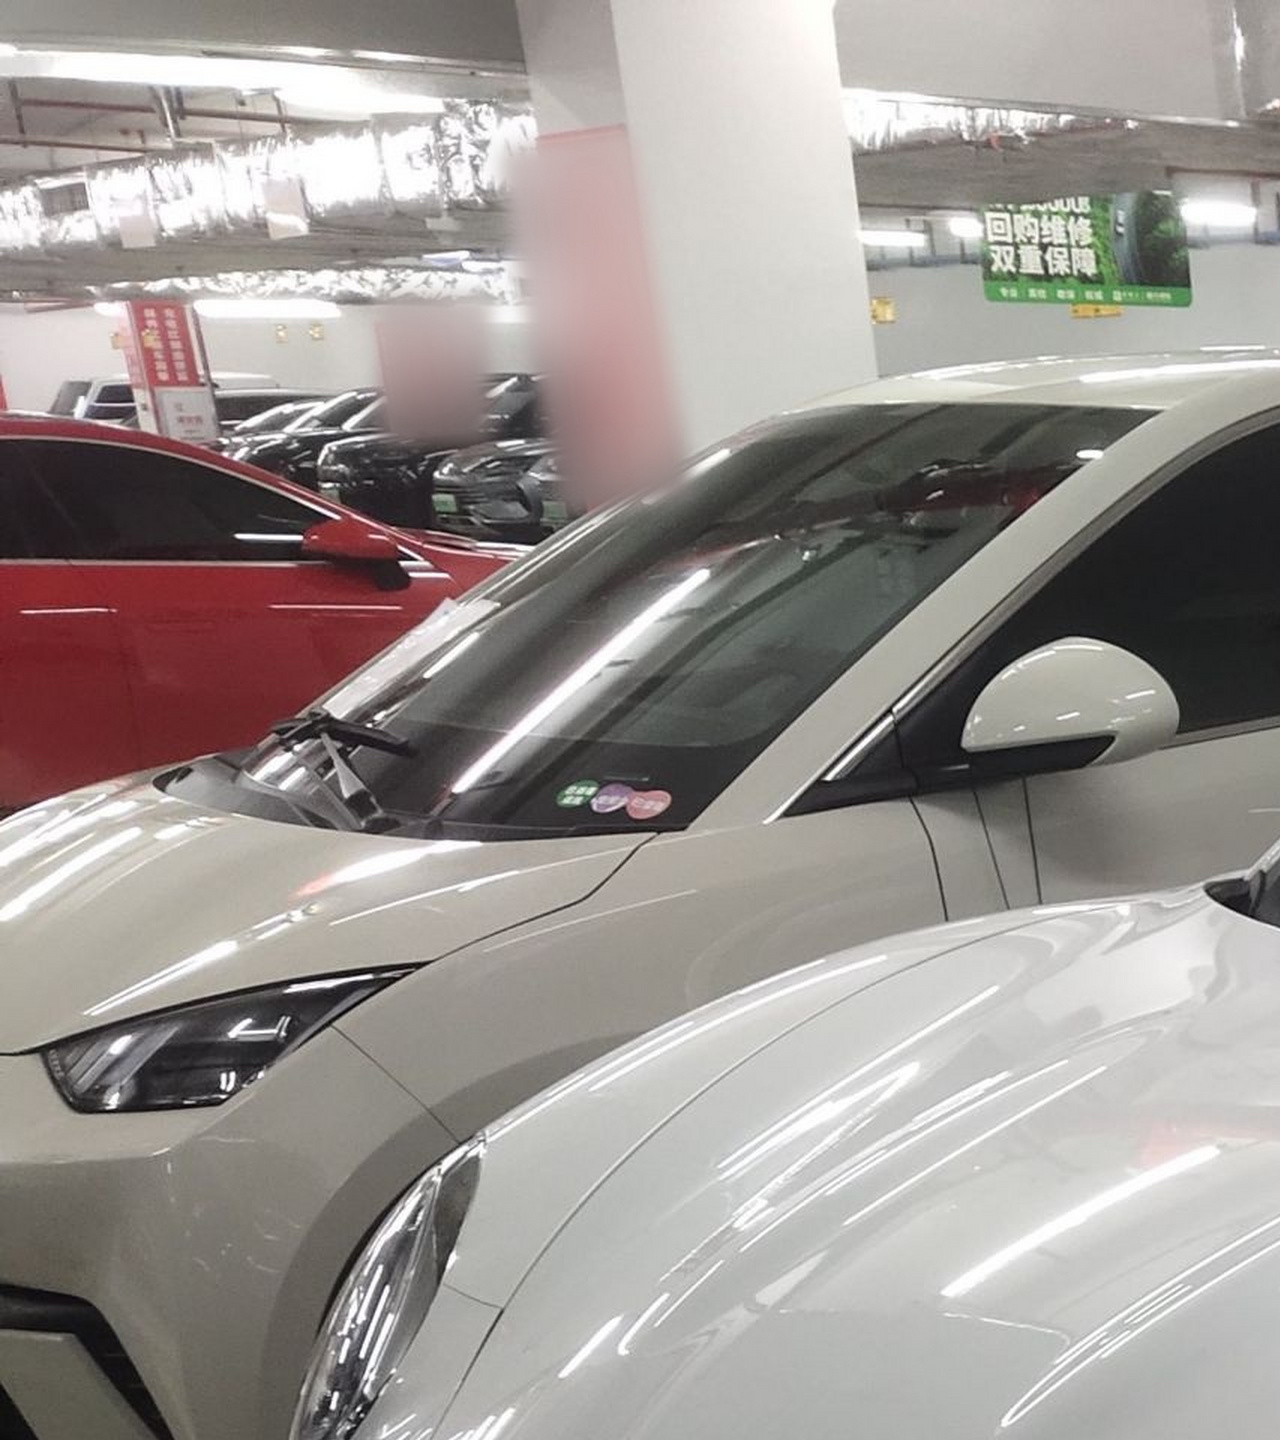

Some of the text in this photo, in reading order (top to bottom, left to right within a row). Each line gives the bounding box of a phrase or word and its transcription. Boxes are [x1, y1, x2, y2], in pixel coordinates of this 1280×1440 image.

[984, 211, 1093, 247] 回购维修
[990, 245, 1097, 277] 双重保障
